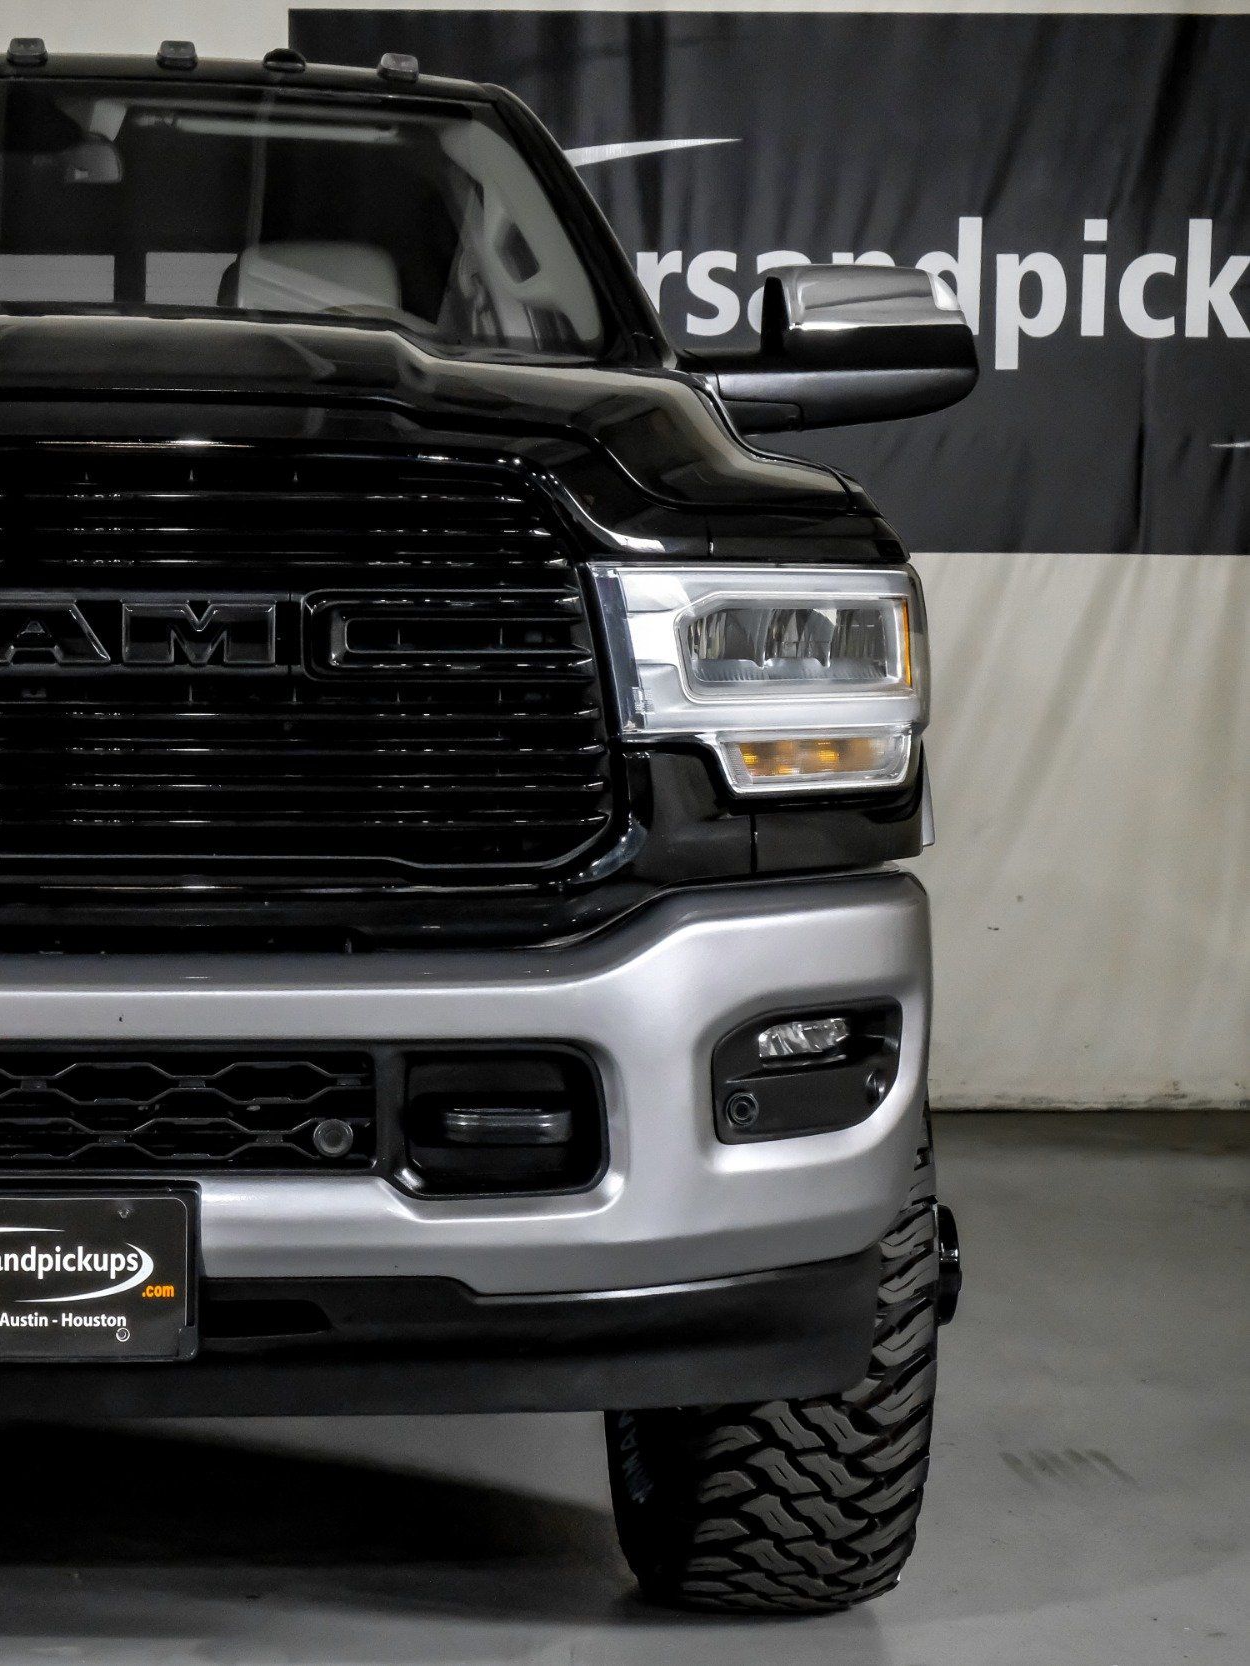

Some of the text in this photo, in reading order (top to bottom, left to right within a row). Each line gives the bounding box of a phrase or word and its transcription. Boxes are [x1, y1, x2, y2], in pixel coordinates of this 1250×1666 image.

[636, 217, 1250, 370] rsdpick
[141, 1283, 175, 1298] .com
[0, 1312, 48, 1327] Austin
[61, 1312, 127, 1327] Houston
